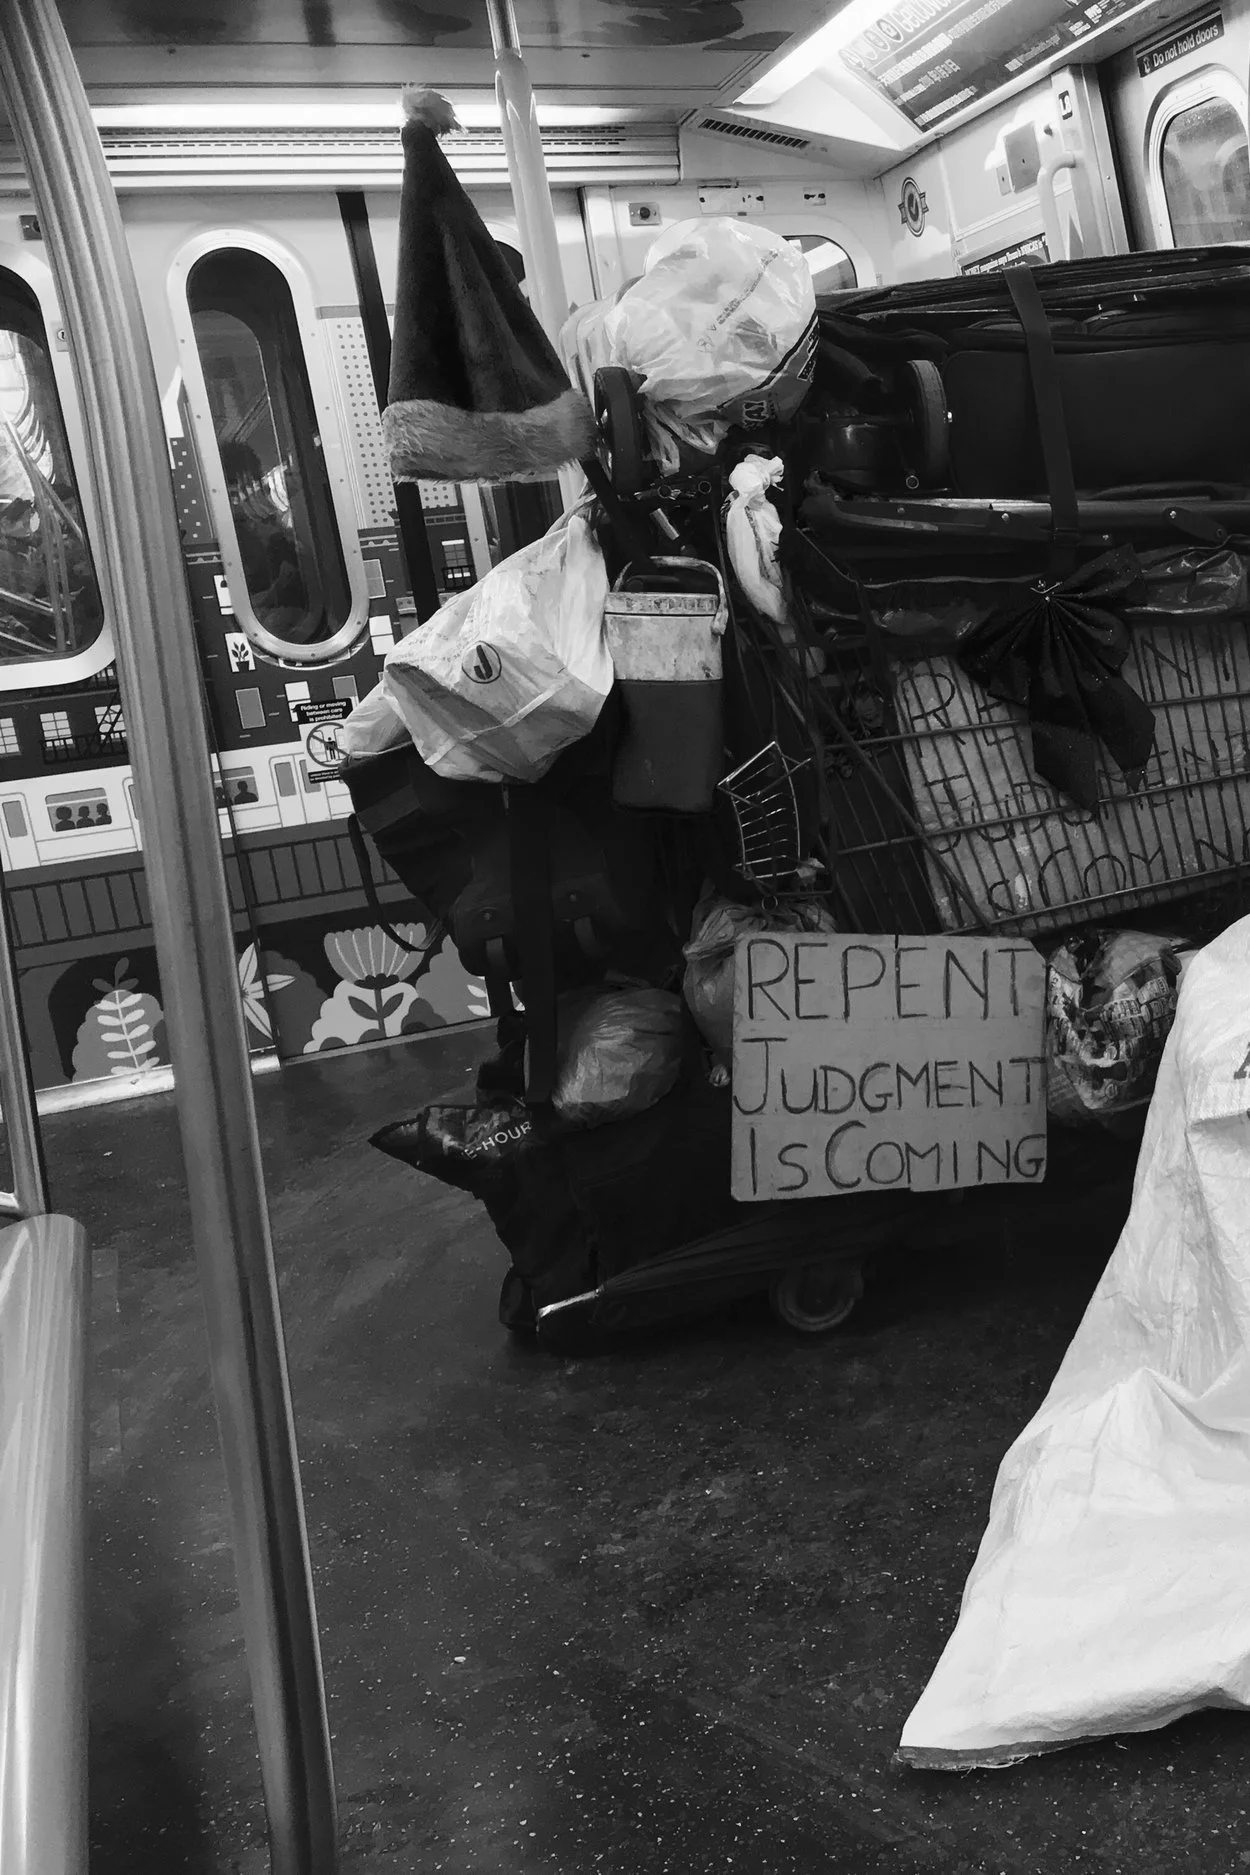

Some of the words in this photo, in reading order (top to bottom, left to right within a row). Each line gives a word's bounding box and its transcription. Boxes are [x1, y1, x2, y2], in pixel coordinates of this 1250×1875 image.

[1152, 53, 1165, 68] Do
[1165, 46, 1178, 62] not
[1177, 35, 1195, 58] hold
[1196, 24, 1219, 46] doors
[747, 938, 1034, 1023] REPENT
[733, 1036, 1047, 1115] JUDGMENT
